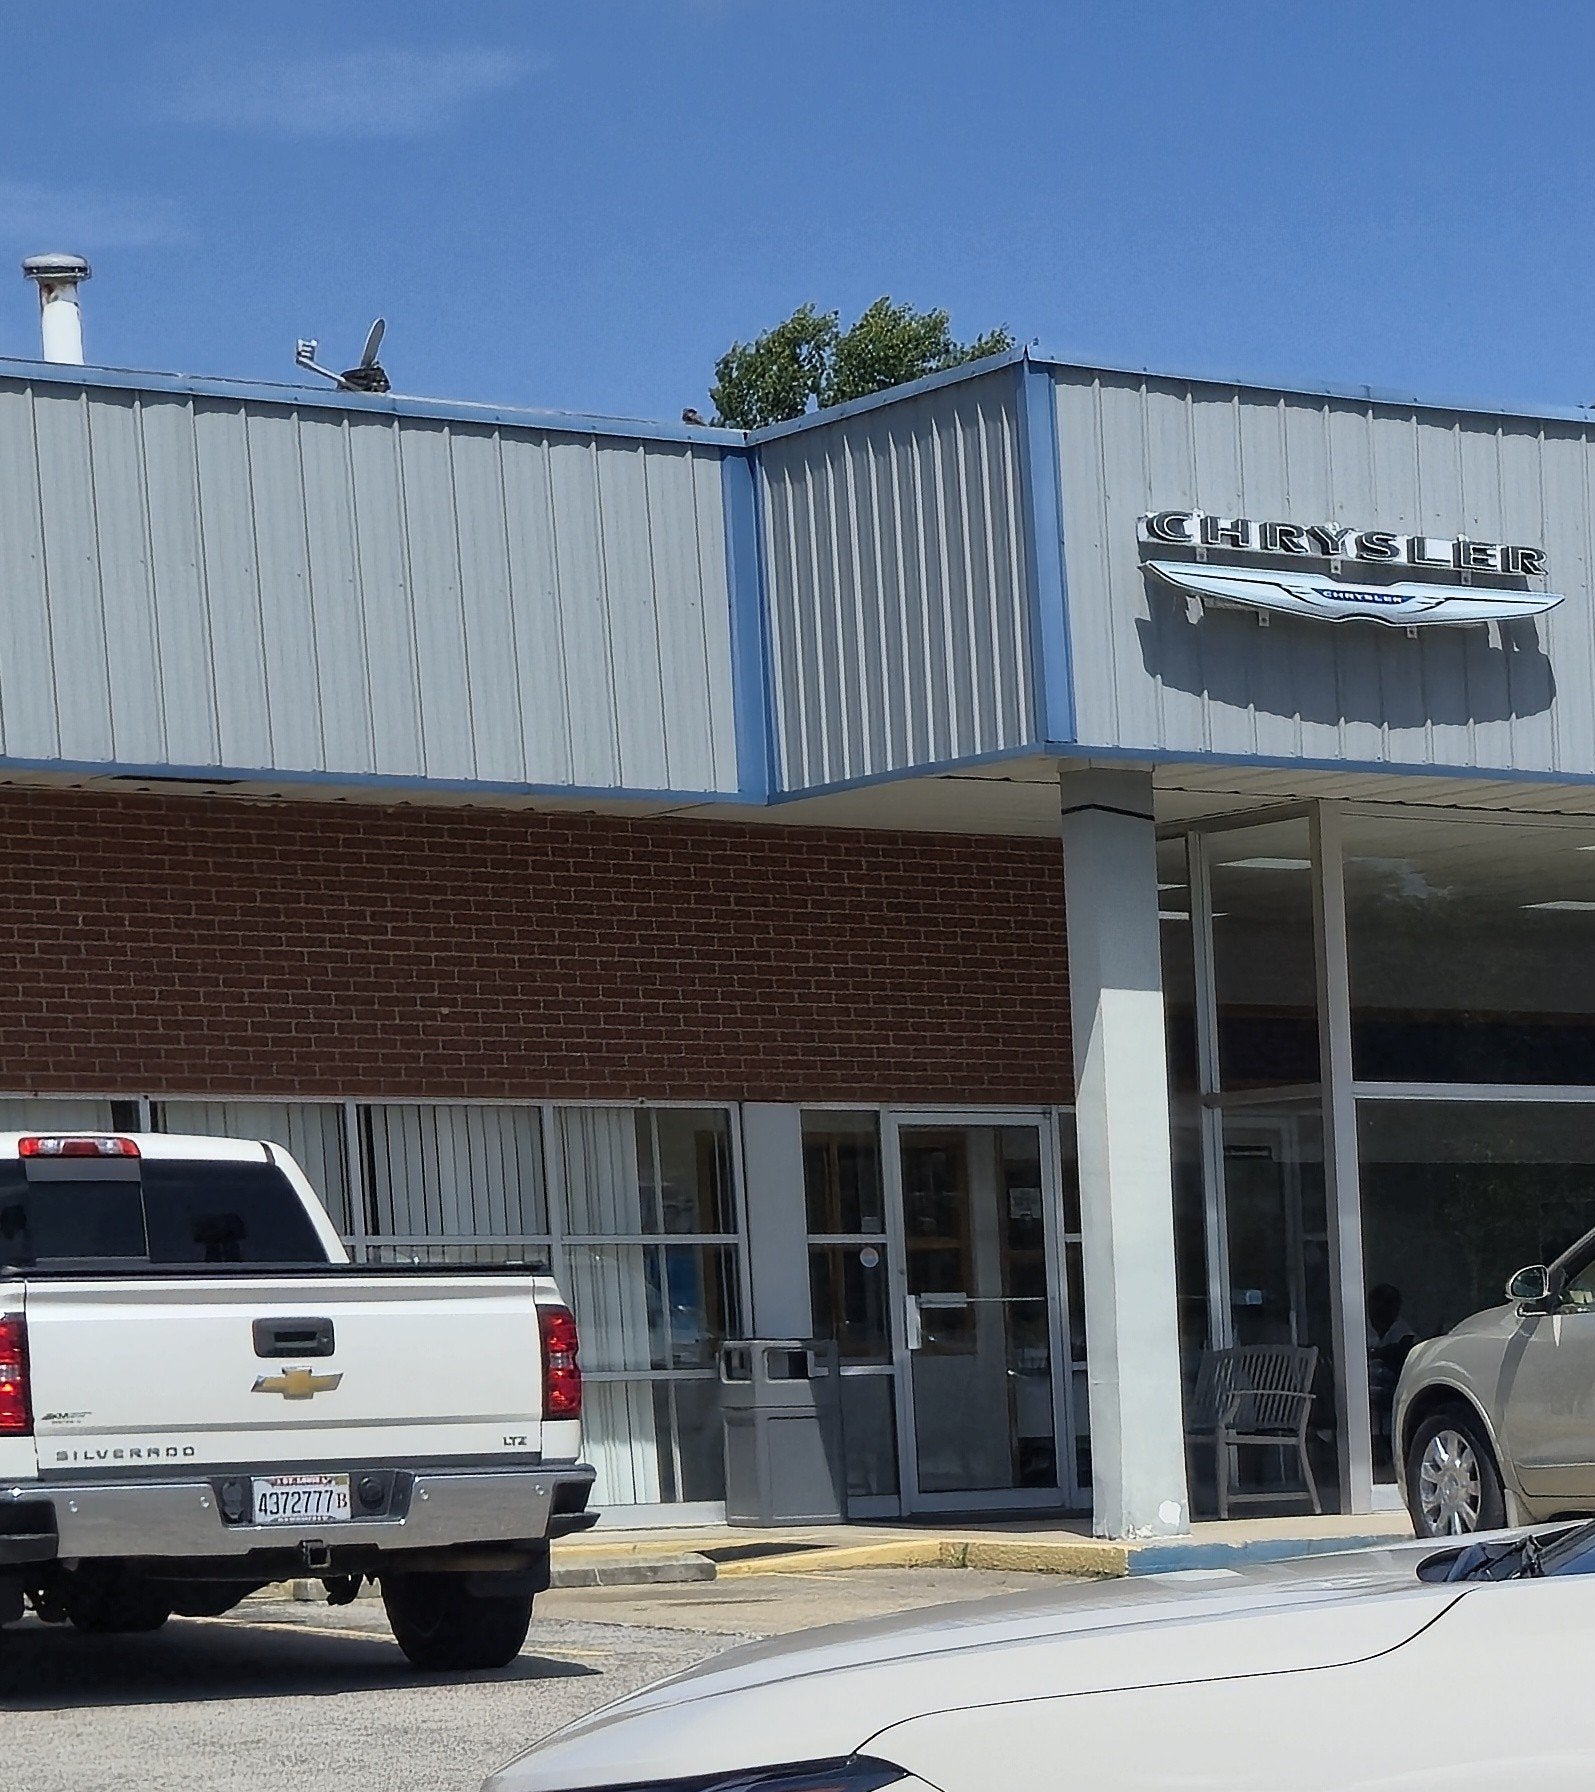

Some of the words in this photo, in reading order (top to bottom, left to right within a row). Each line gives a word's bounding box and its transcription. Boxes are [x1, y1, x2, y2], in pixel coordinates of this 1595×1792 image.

[1146, 510, 1548, 576] CHRYSLER
[1322, 591, 1402, 603] CHRYSLER
[502, 1436, 528, 1446] LTZ
[56, 1446, 195, 1462] SILVERADO
[258, 1489, 334, 1517] 4372777
[336, 1492, 348, 1509] B
